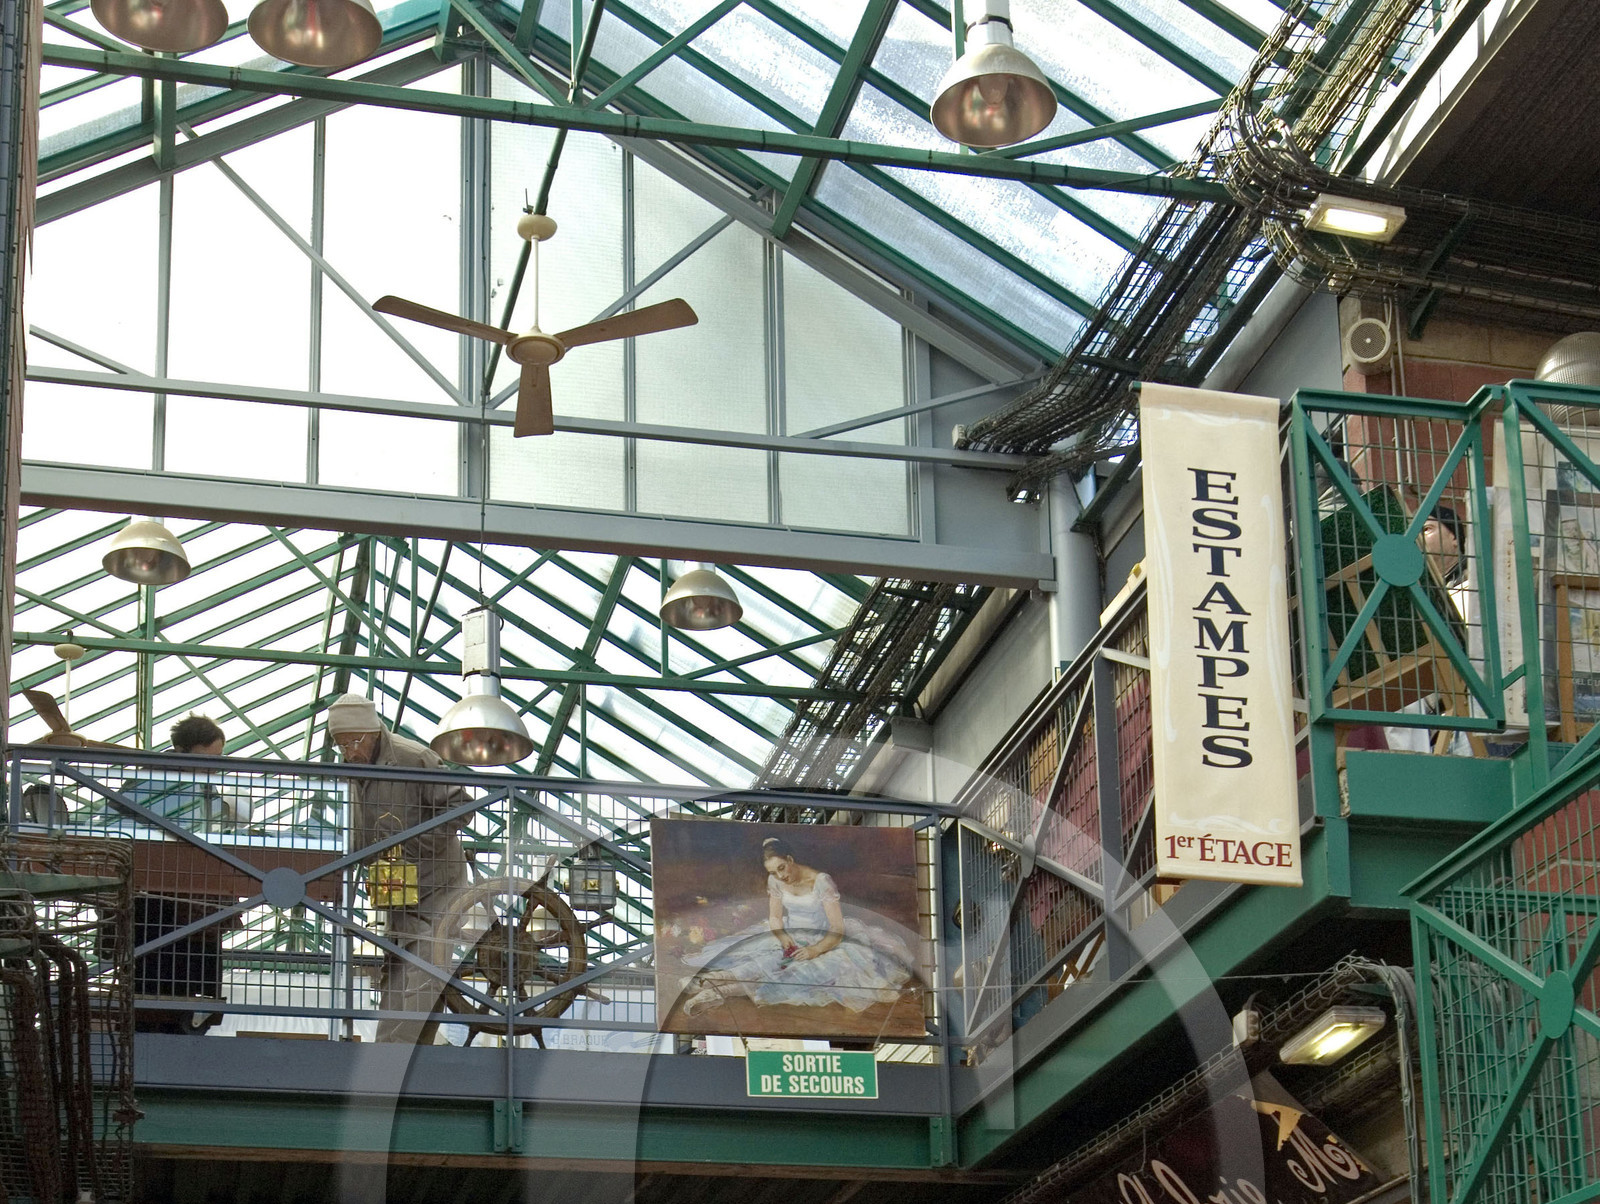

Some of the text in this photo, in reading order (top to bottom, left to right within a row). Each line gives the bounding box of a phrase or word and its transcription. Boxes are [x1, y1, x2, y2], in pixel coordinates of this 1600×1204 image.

[1186, 467, 1253, 769] ESTAMPES
[1165, 832, 1293, 868] 1er ÉTAGE
[782, 1054, 842, 1073] SORTIE
[760, 1075, 865, 1095] DE SECOURS
